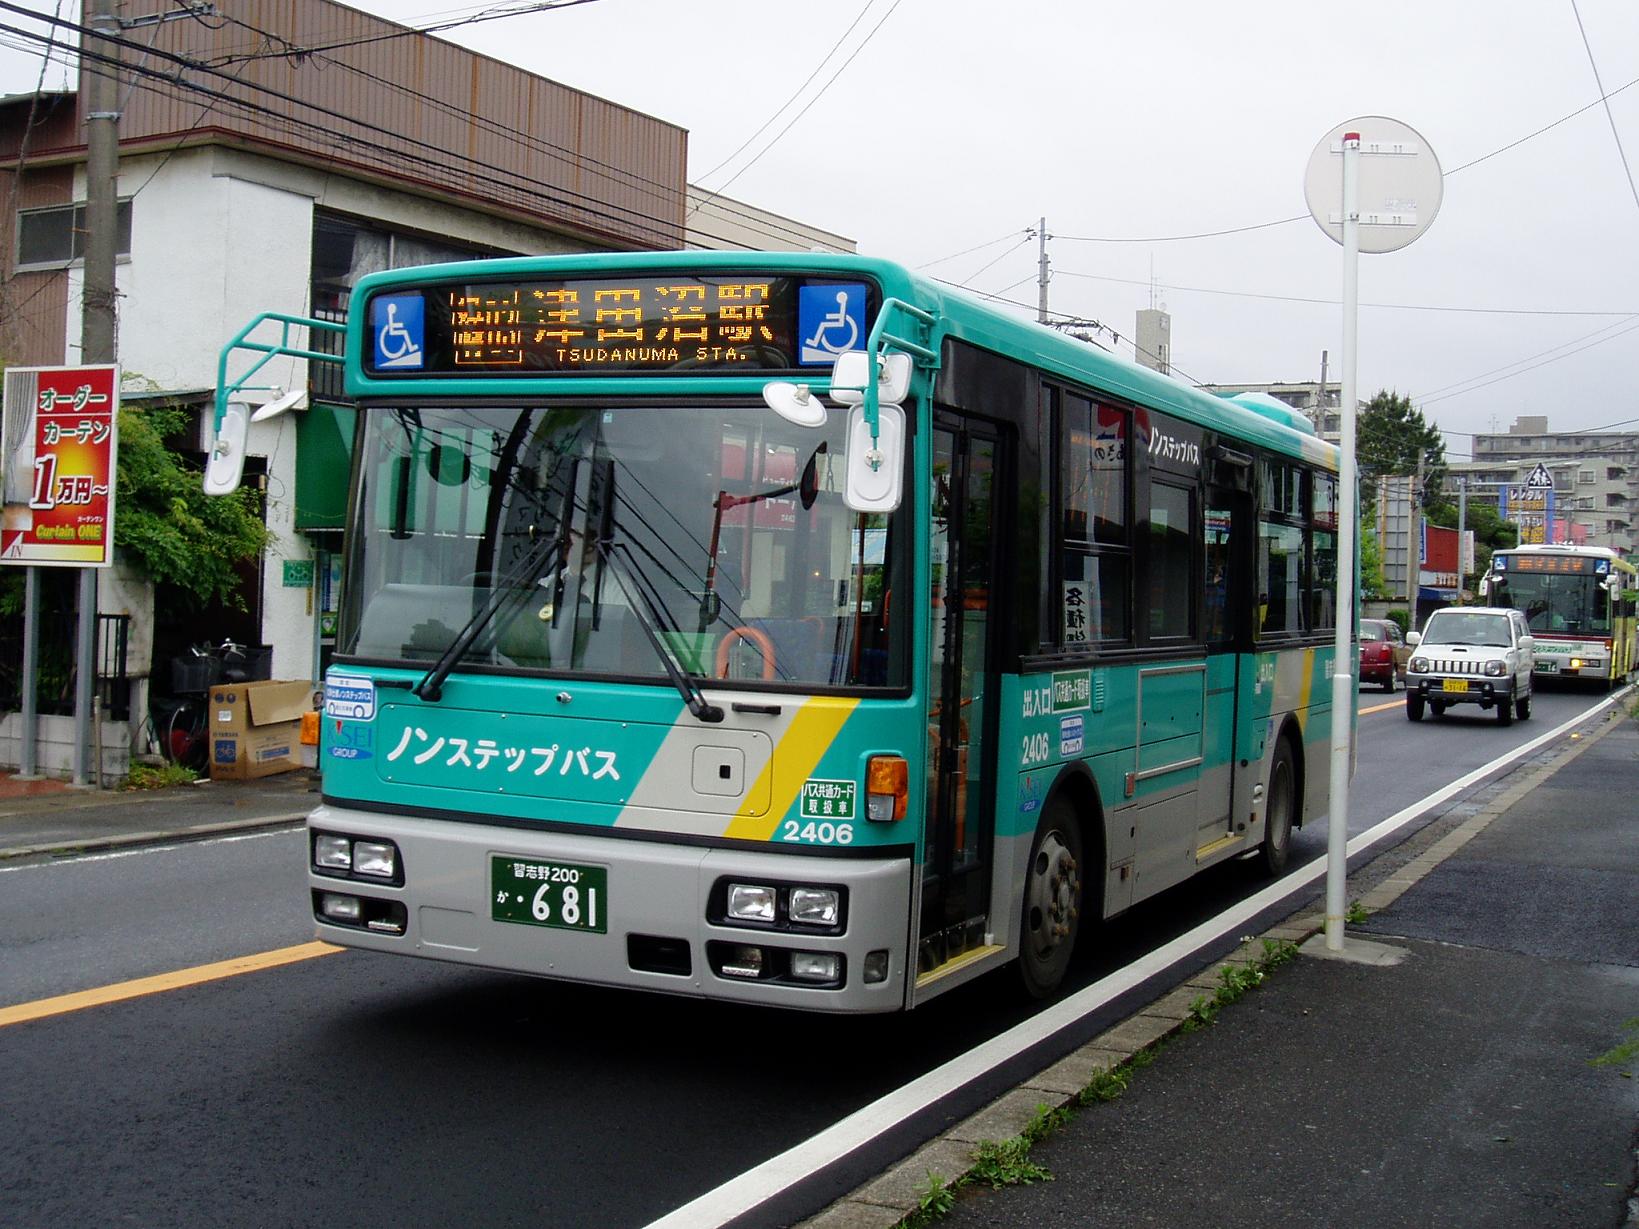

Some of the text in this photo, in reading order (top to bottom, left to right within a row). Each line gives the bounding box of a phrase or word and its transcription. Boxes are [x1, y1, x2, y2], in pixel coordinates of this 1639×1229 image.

[533, 284, 773, 345] 津田沼駅
[557, 347, 747, 362] TSUDANUMA STA.
[39, 384, 107, 412] オーダー
[43, 420, 110, 445] カーテン
[1148, 426, 1200, 466] ノンステップバス
[36, 524, 103, 540] Curtain ONE
[1023, 687, 1051, 718] 出入口
[332, 746, 358, 759] GROUP
[387, 726, 620, 781] ノンステップバス
[1022, 732, 1049, 765] 2406
[804, 783, 854, 799] バス共通カード
[808, 799, 848, 815] 取扱車
[783, 820, 854, 844] 2406
